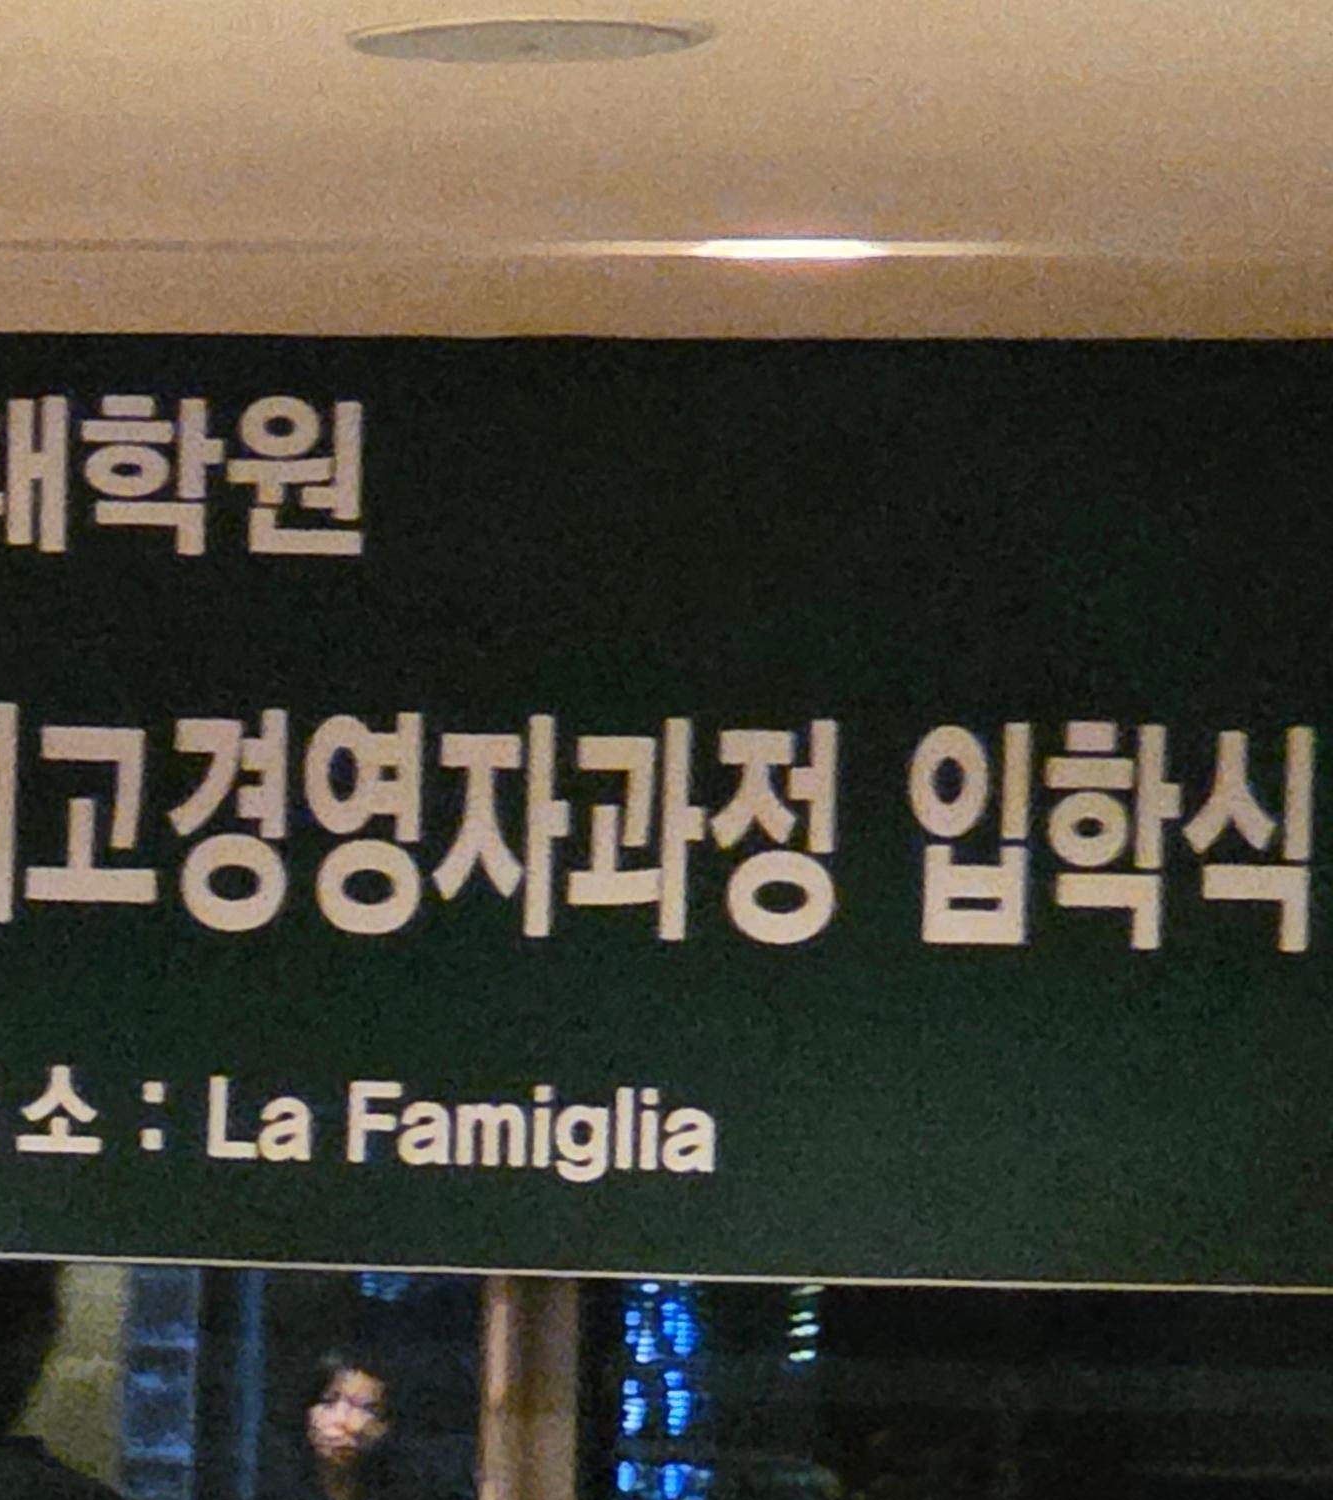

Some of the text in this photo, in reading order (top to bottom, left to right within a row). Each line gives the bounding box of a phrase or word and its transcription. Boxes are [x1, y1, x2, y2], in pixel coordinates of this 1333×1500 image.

[909, 721, 1314, 953] 입학식
[206, 1075, 313, 1162] La
[346, 1080, 717, 1183] Famiglia
